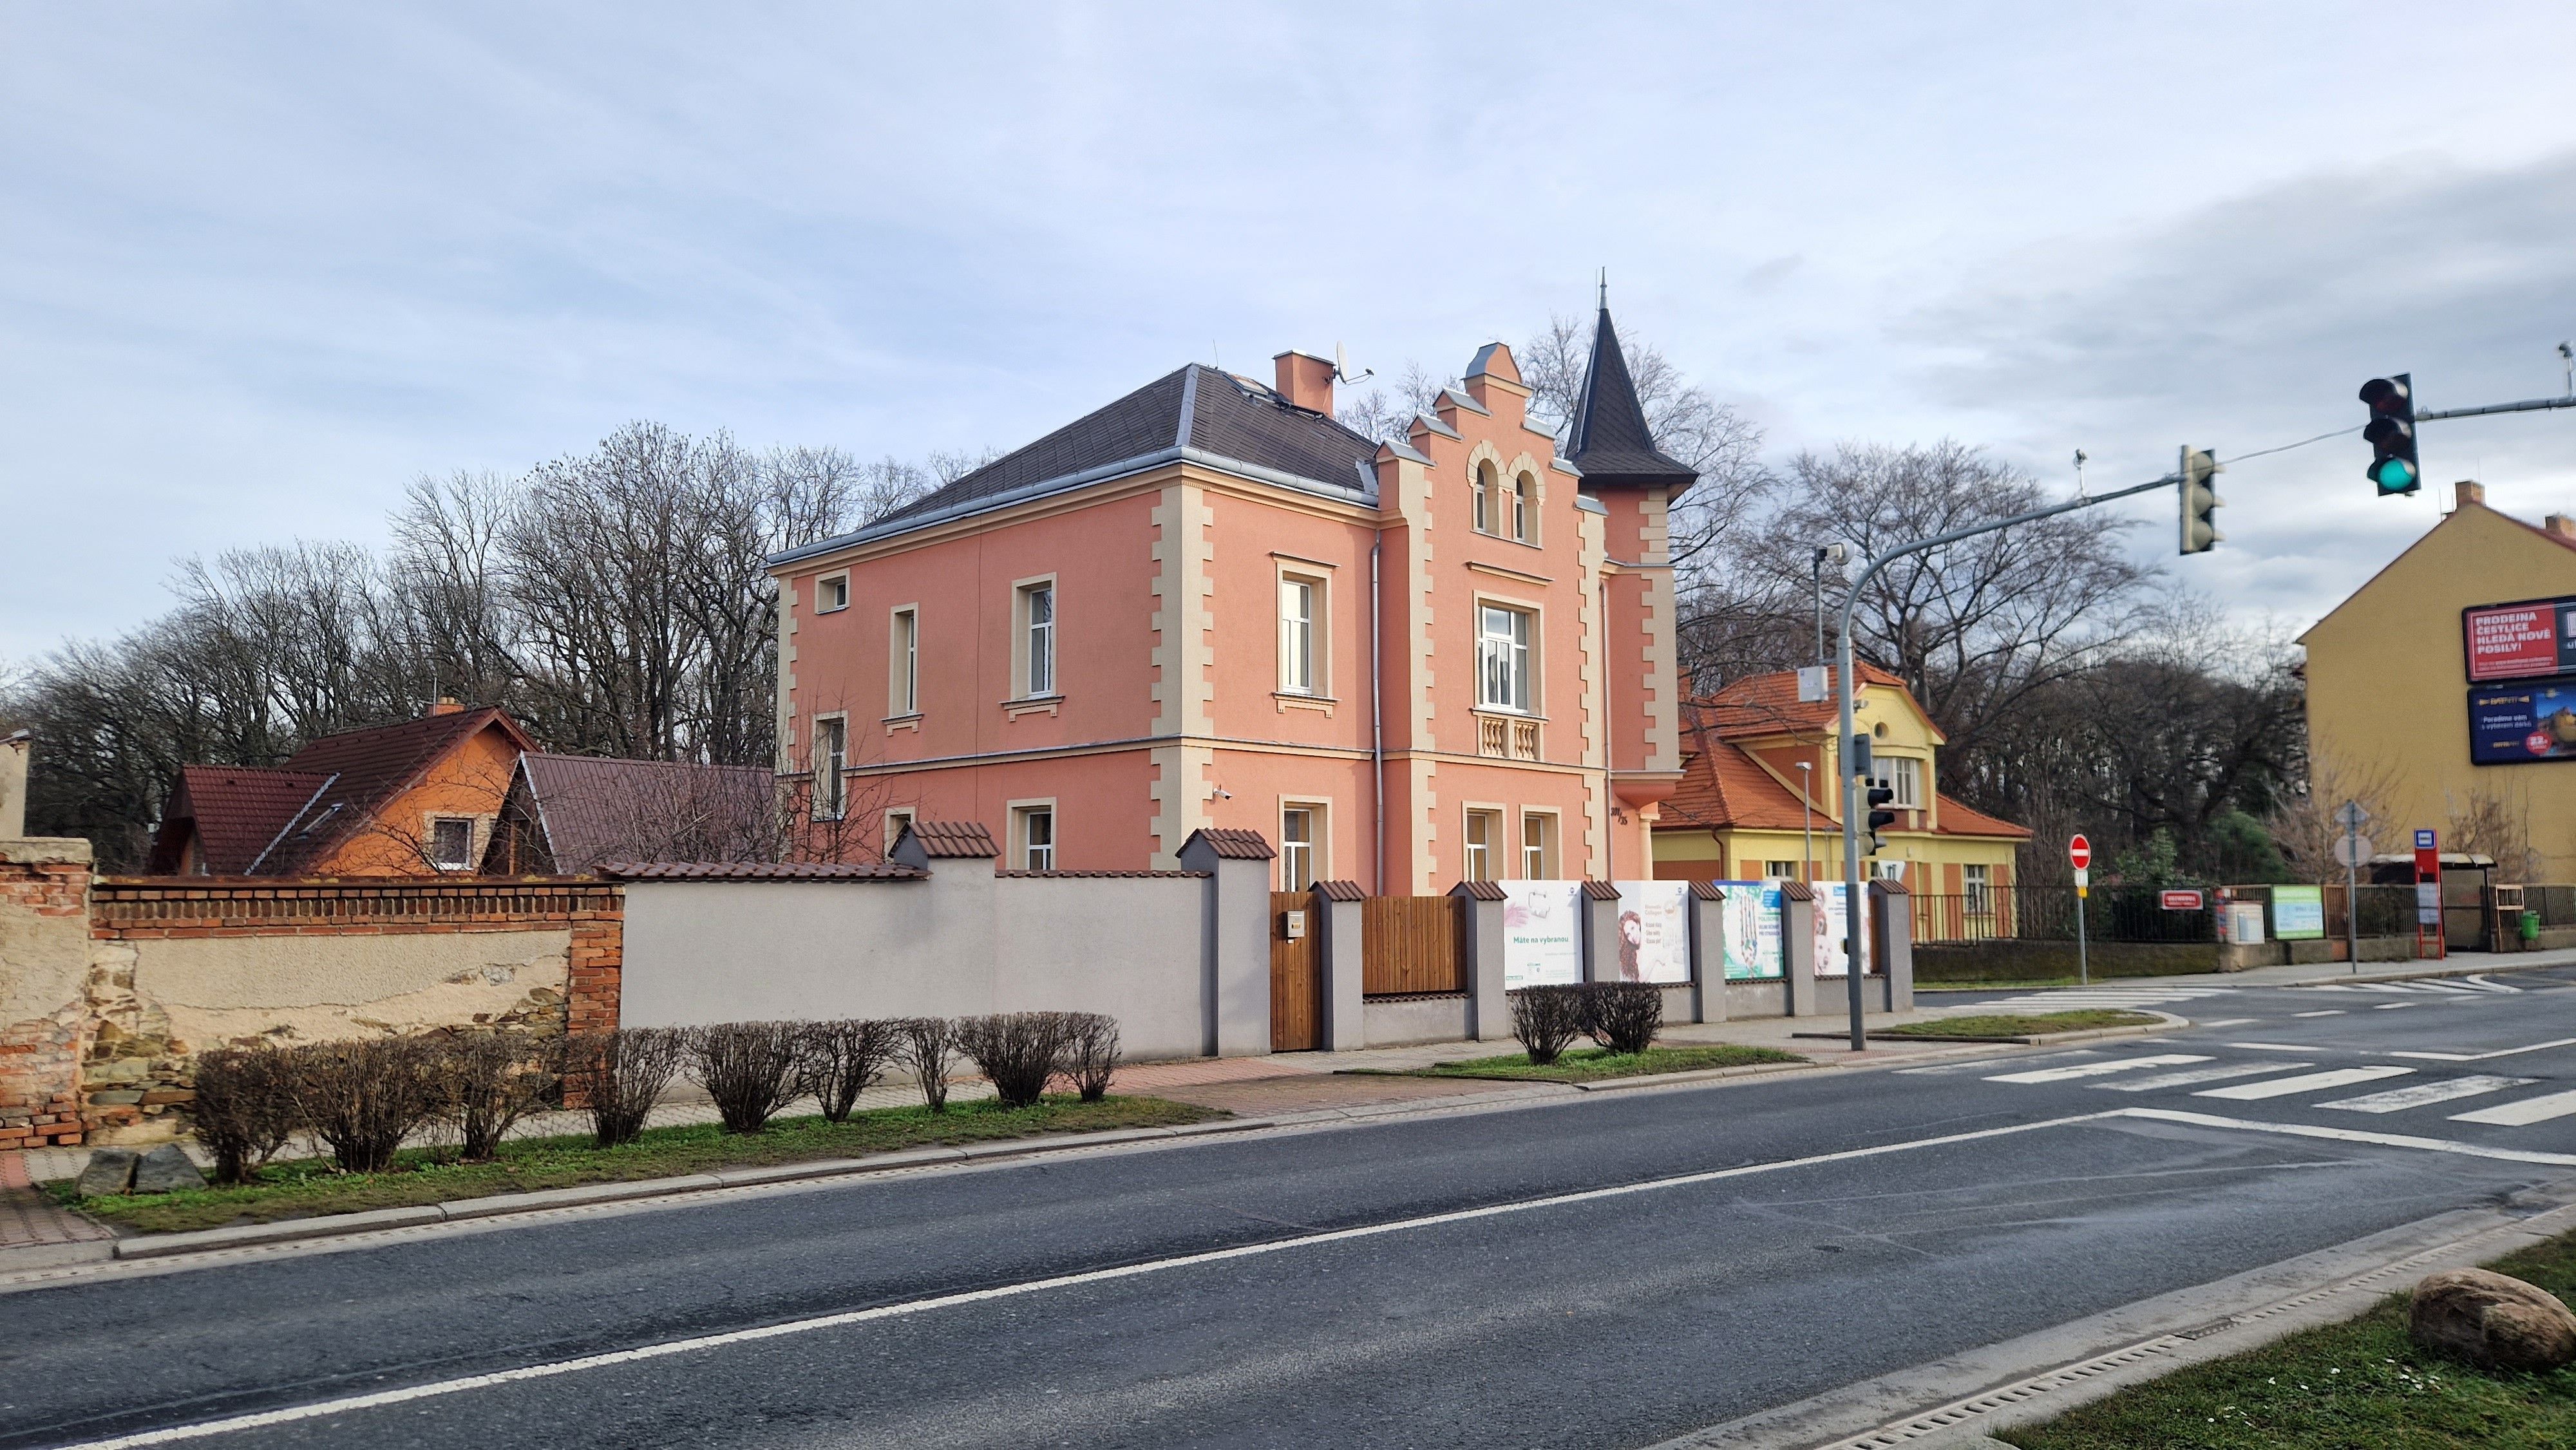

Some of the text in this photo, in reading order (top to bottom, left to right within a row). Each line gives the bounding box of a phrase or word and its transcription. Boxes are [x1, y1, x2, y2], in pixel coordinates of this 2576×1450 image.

[2476, 612, 2537, 626] PRODEJNA
[2517, 627, 2552, 641] NOVÉ
[2477, 642, 2522, 655] POSILY!
[1513, 936, 1530, 945] Máte
[1540, 935, 1569, 945] vybranou
